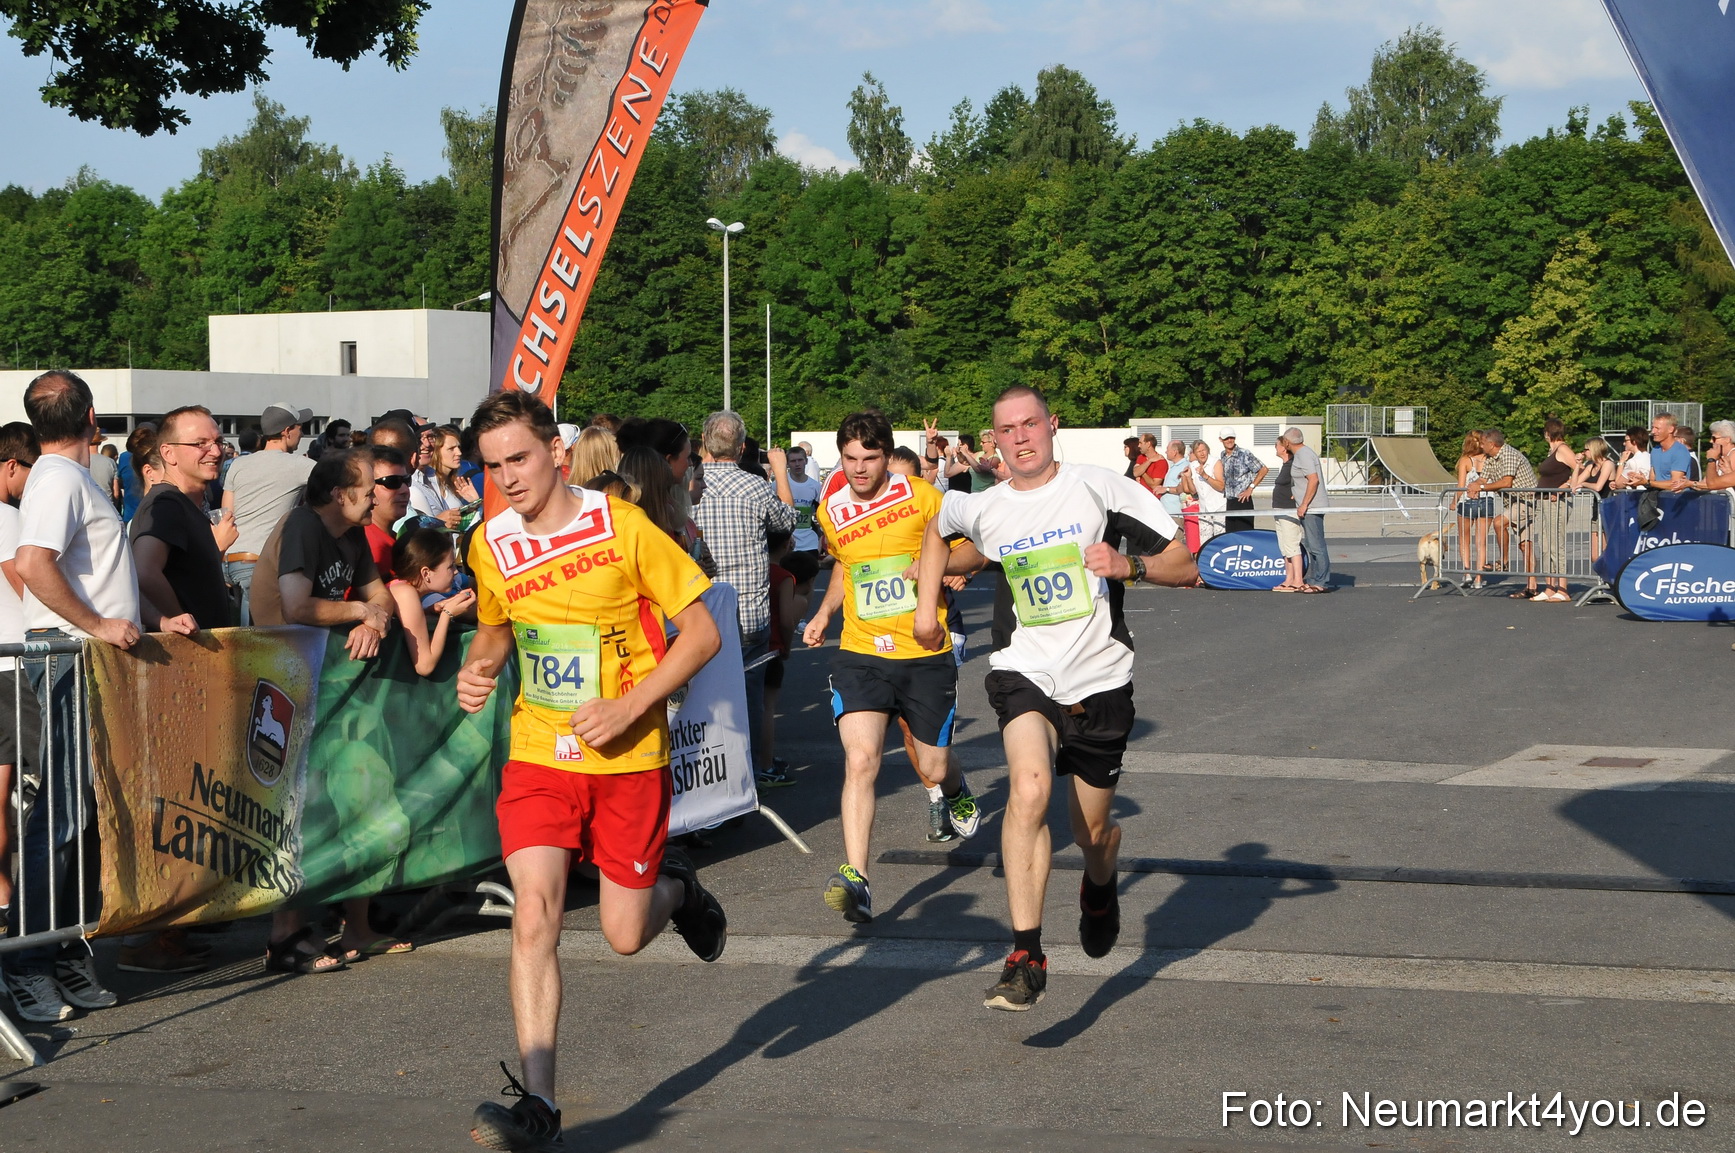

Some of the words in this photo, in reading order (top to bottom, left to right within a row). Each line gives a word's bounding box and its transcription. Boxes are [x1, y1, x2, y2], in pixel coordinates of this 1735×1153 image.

[513, 0, 681, 395] CHSELSZENE.D
[796, 514, 809, 524] 02
[837, 523, 872, 549] MAX
[877, 504, 919, 530] BÖGL
[999, 523, 1083, 556] DELPHI
[505, 571, 558, 604] MAX
[561, 548, 623, 581] BÖGL
[1225, 555, 1285, 571] Fische
[861, 577, 905, 606] 760
[1021, 572, 1073, 607] 199
[1655, 577, 1735, 595] Fische
[1664, 596, 1735, 604] AUTOMOBIL
[526, 653, 584, 690] 784
[669, 719, 707, 752] arkter
[254, 755, 275, 778] 1628
[671, 746, 728, 797] sbräu
